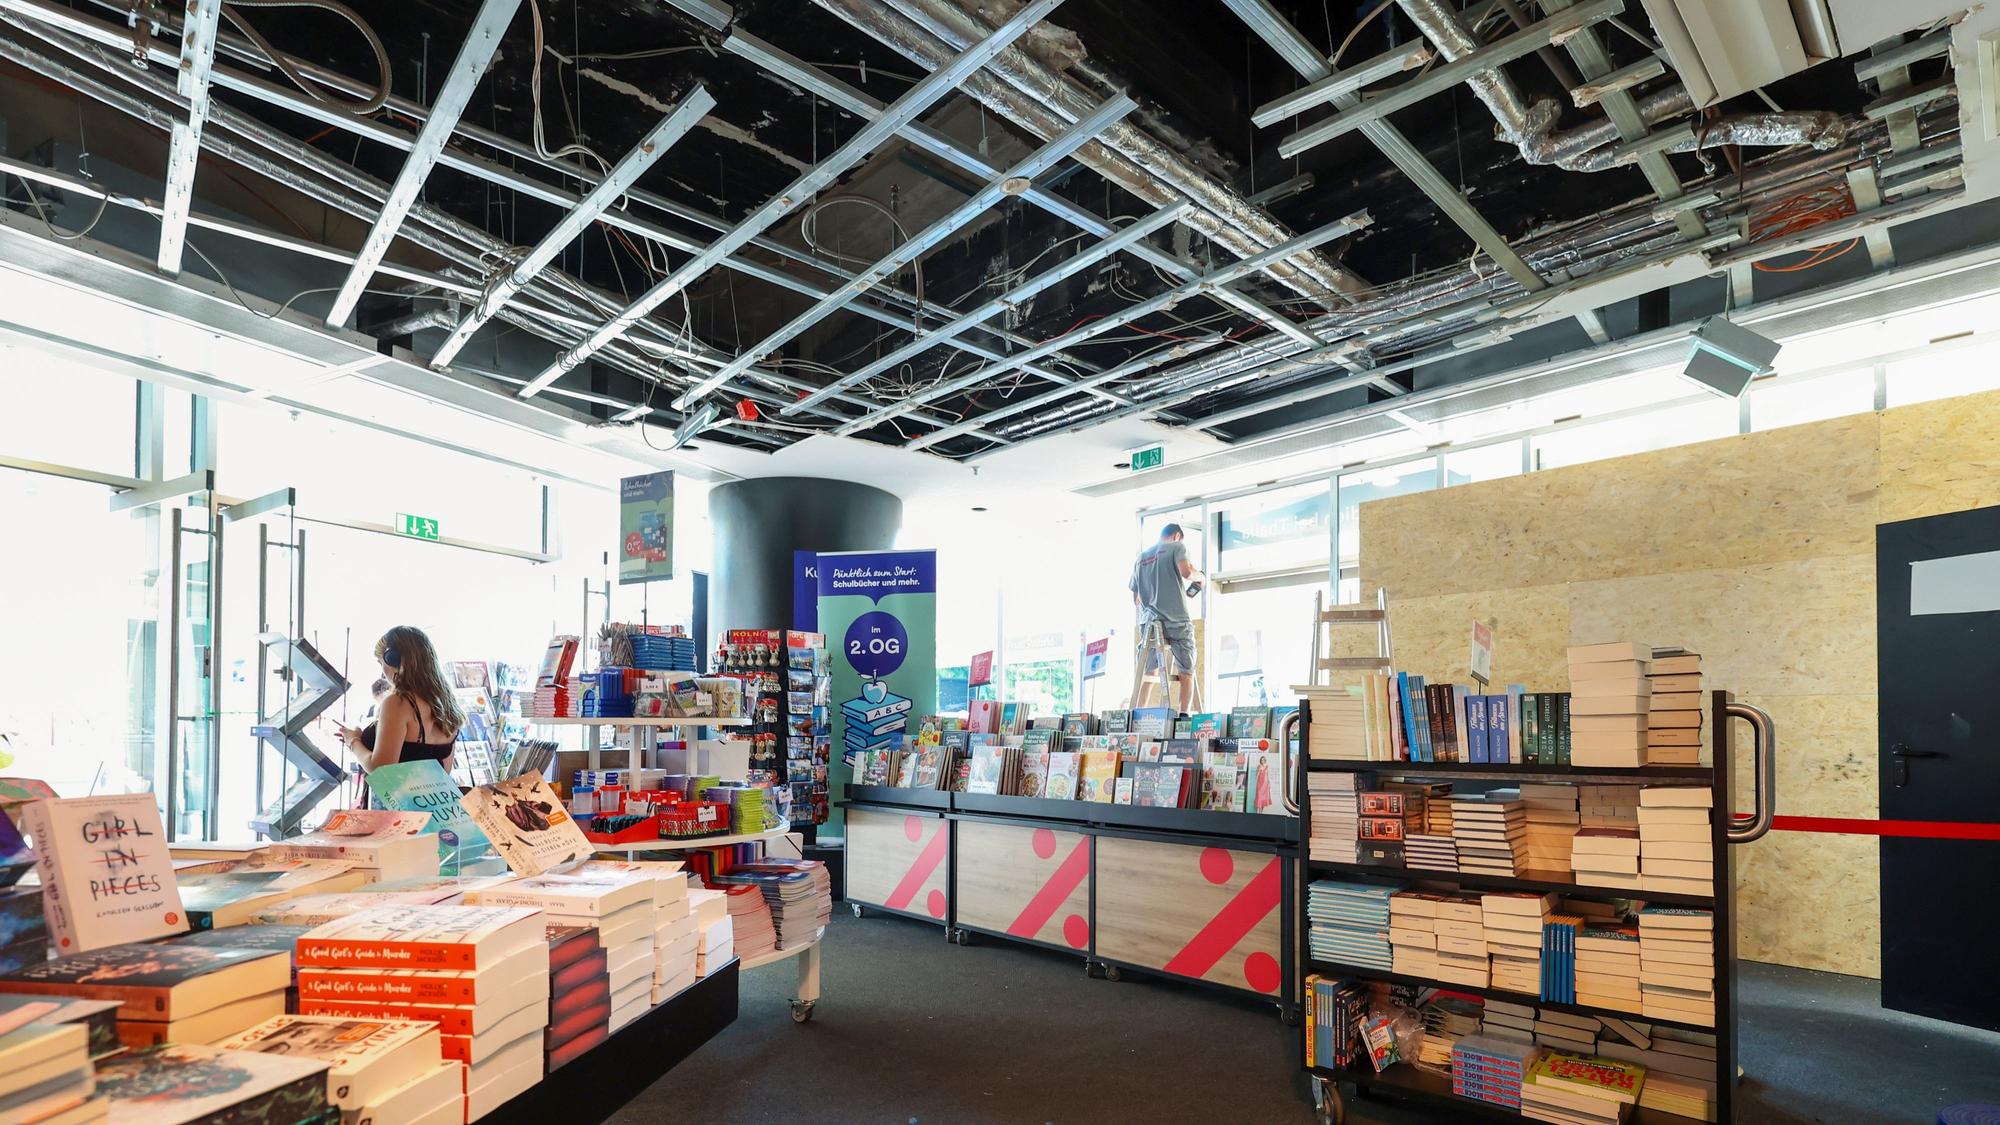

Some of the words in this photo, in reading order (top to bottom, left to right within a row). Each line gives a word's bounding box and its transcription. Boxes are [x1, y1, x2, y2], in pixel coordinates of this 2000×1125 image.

[833, 567, 872, 578] Pünktlich
[894, 565, 917, 576] Start:
[833, 580, 880, 588] Schulbücher
[882, 579, 896, 587] und
[898, 578, 920, 586] mehr.
[850, 640, 866, 655] 2.
[869, 639, 900, 654] OG
[874, 710, 881, 719] A
[885, 706, 892, 714] B
[1193, 730, 1219, 739] YOGA
[413, 790, 461, 808] CULPA
[82, 816, 153, 844] GIRL
[104, 848, 138, 869] IN
[90, 874, 161, 901] PIECES
[310, 946, 330, 958] Good
[354, 947, 376, 959] Guide
[382, 948, 412, 959] Murder
[313, 980, 332, 992] Good
[357, 982, 377, 993] Guide
[383, 982, 412, 994] Murder
[243, 1029, 265, 1043] OF
[347, 1022, 413, 1055] LYING
